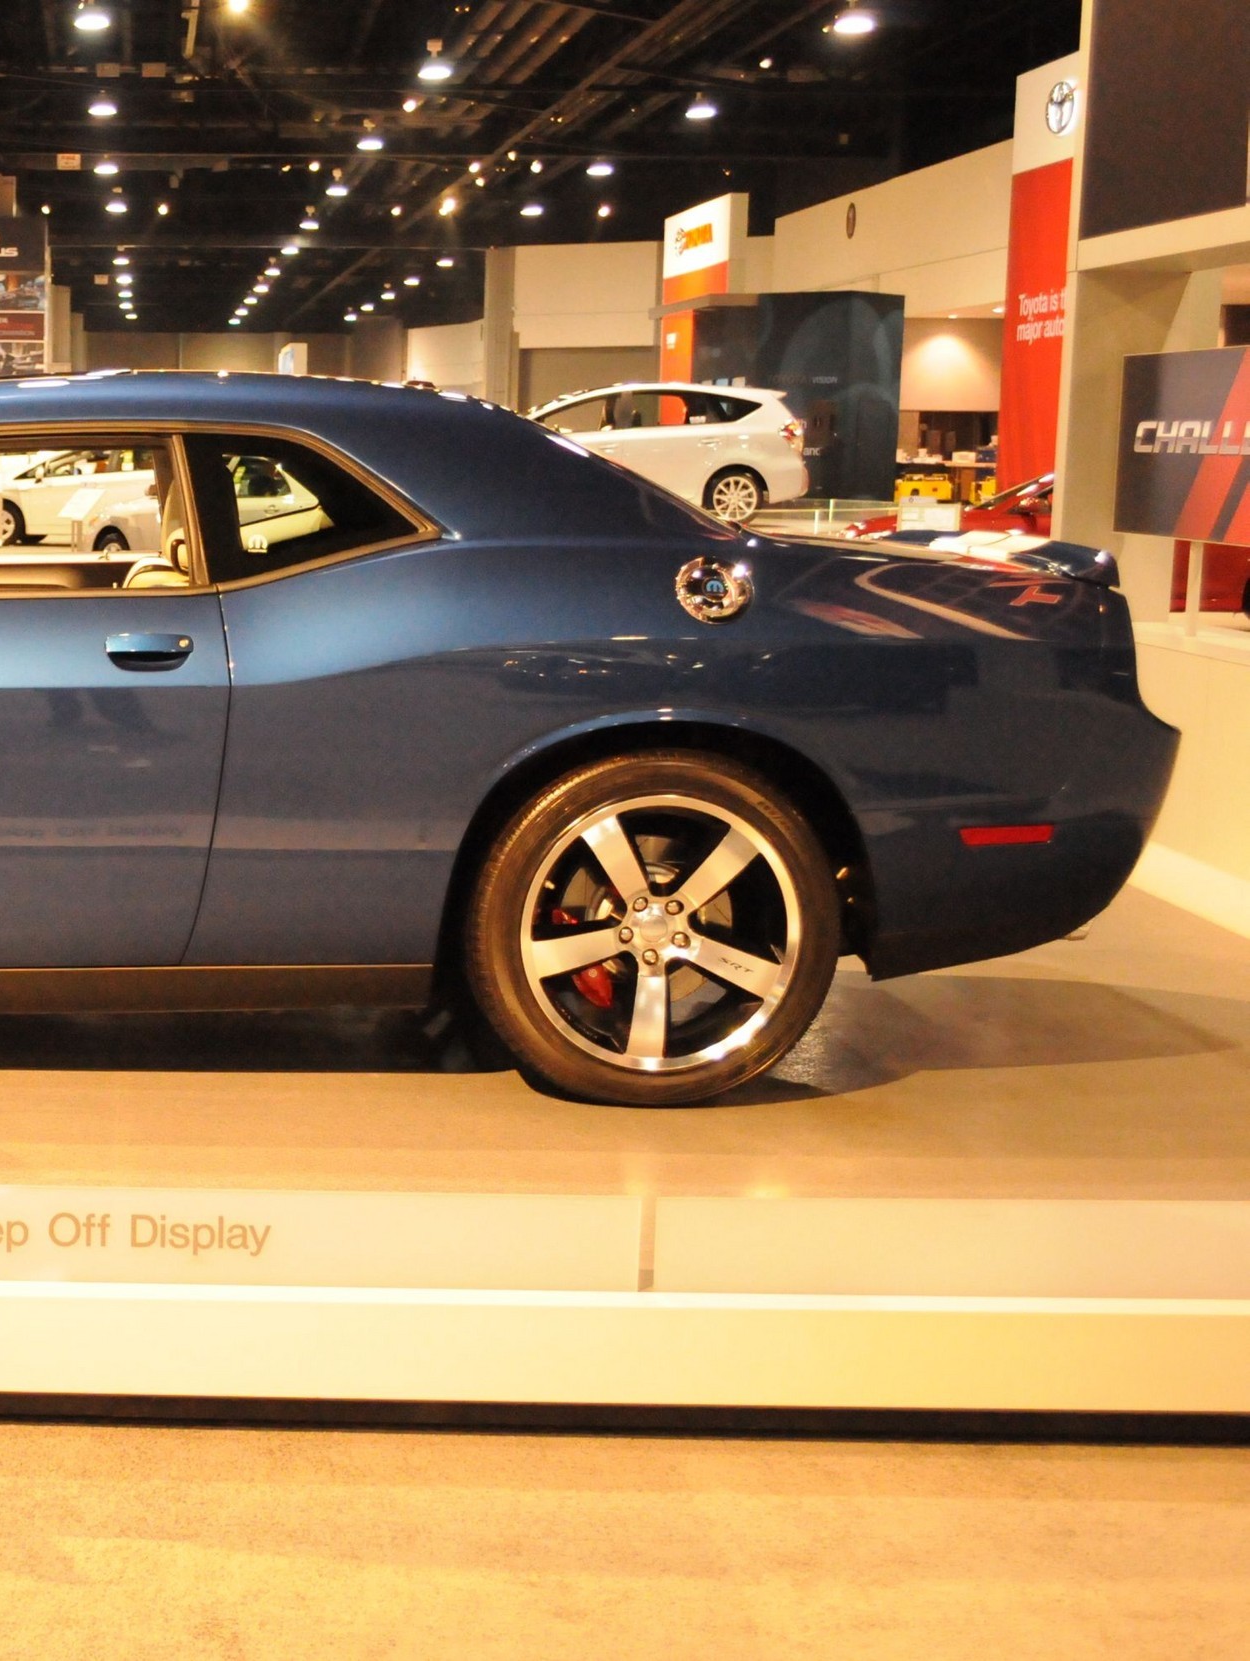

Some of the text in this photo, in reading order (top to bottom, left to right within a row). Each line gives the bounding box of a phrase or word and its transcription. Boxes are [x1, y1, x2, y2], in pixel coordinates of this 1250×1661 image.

[1018, 292, 1048, 322] Toyota
[1050, 288, 1058, 312] is
[1017, 321, 1043, 346] major
[718, 956, 754, 974] SRT
[48, 1212, 111, 1248] Off
[130, 1213, 272, 1258] Display
